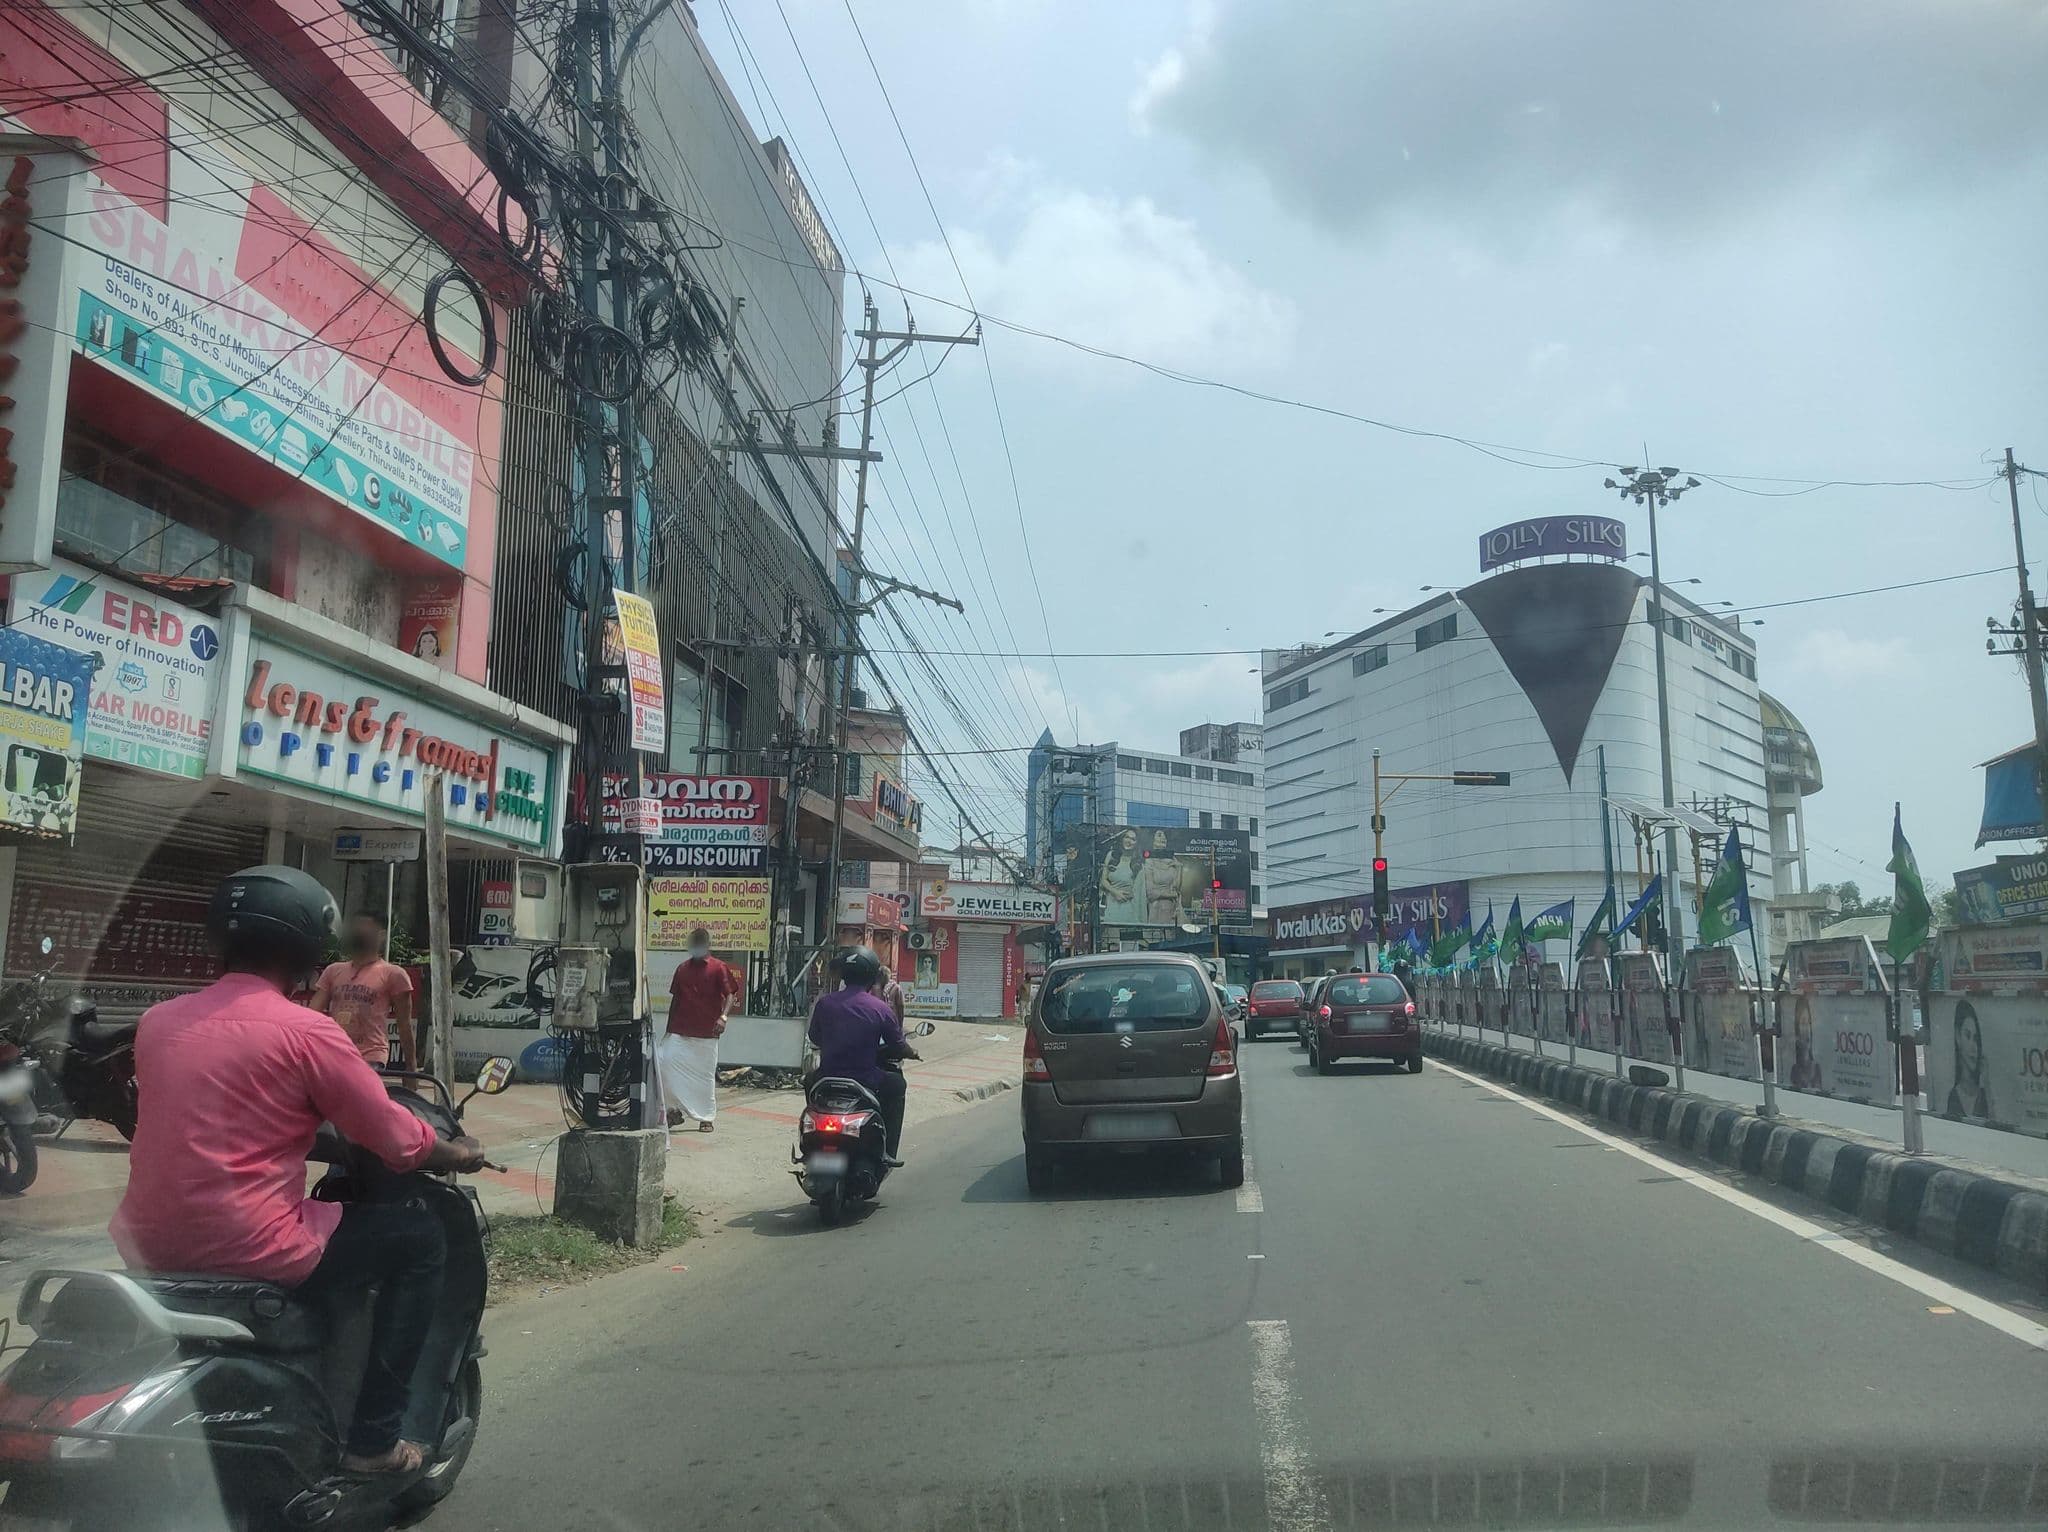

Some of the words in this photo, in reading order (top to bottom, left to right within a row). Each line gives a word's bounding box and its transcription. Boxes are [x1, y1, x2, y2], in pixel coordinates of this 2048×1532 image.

[89, 191, 329, 391] SHANKAR
[343, 364, 472, 487] MOBILE
[105, 277, 138, 311] Shop
[142, 301, 161, 324] No.
[273, 386, 298, 409] Near
[297, 403, 325, 431] Bhima
[105, 255, 153, 297] Dealers
[157, 291, 171, 308] of
[172, 299, 188, 319] All
[191, 311, 217, 339] Kind
[219, 330, 234, 347] of
[233, 338, 272, 376] Mobiles
[273, 367, 333, 418] Accessories,
[335, 408, 361, 435] Spare
[362, 426, 384, 450] Parts
[384, 441, 391, 455] &
[393, 446, 415, 471] SMPS
[417, 462, 441, 487] Power
[102, 590, 184, 647] ERD
[622, 613, 656, 637] TUITION
[28, 606, 59, 631] The
[64, 618, 112, 648] Power
[115, 638, 131, 652] of
[134, 641, 206, 677] Innovation
[122, 674, 143, 687] 1997
[630, 664, 662, 686] ENTRANCE
[28, 719, 65, 741] SHAKE
[131, 700, 211, 738] MOBILE
[241, 721, 490, 812] OPTICINS
[504, 766, 537, 794] EYE
[495, 790, 545, 823] CLINIC
[622, 799, 652, 813] SYDNEY
[2004, 826, 2036, 838] OFFICE
[364, 839, 416, 851] Experts
[676, 846, 761, 866] DISCOUNT
[924, 895, 955, 912] SP
[957, 897, 1053, 912] JEWELLERY
[1996, 885, 2027, 903] OFFICE
[984, 910, 1024, 918] DIAMOND
[1275, 912, 1347, 941] Joyalukkas
[934, 940, 950, 950] SP
[915, 995, 954, 1003] JEWELLERY
[1833, 1031, 1874, 1056] JOSCO
